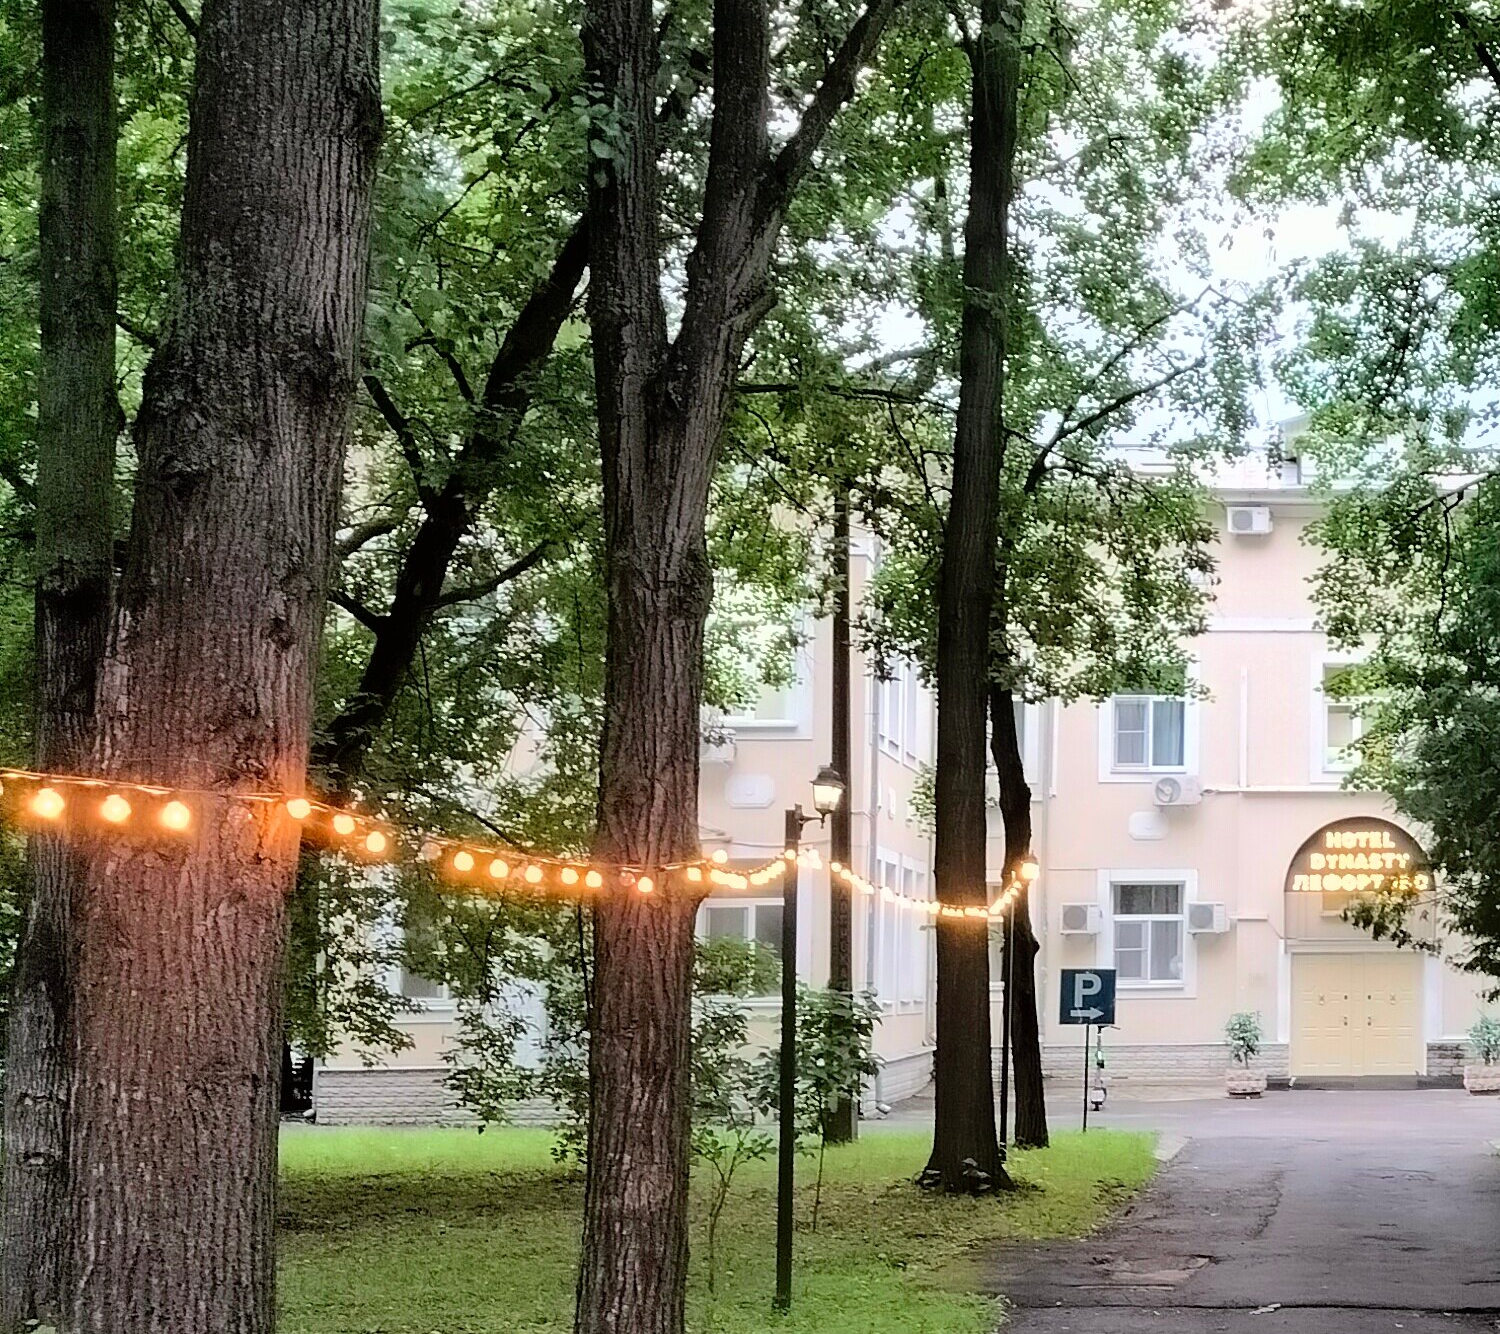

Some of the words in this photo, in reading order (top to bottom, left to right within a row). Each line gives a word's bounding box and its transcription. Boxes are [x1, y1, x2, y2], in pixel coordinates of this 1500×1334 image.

[1326, 832, 1395, 849] HOTEL
[1310, 853, 1410, 870] DYNASTY
[1292, 873, 1428, 891] ЛЕФОРТВО
[1074, 973, 1102, 1008] P
